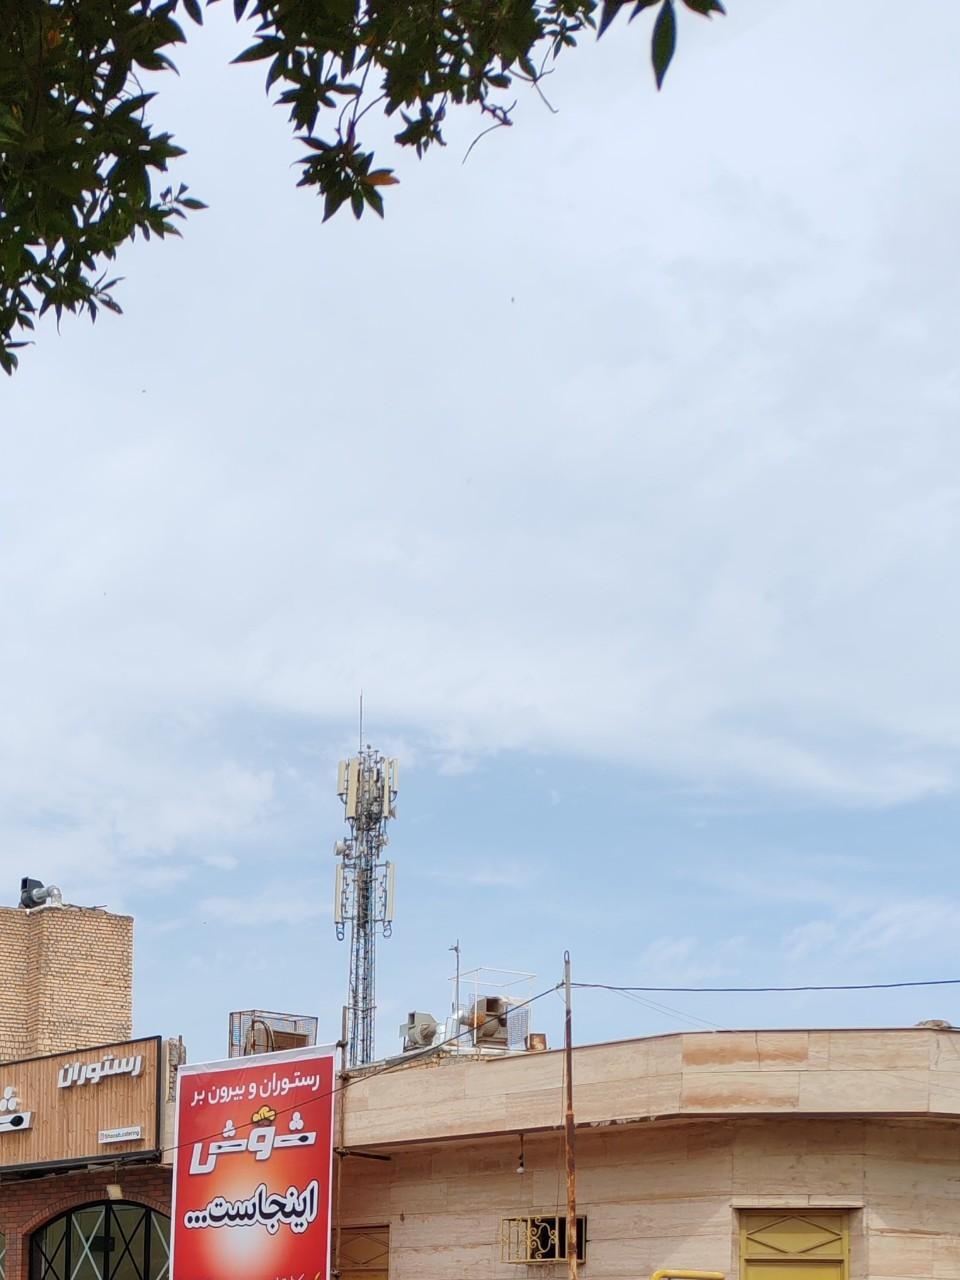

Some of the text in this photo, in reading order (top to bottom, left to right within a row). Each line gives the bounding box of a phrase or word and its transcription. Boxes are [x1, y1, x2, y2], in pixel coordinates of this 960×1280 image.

[58, 1053, 144, 1089] رستوران
[191, 1072, 320, 1106] رستوران و بیرون بر
[189, 1111, 317, 1175] شوش
